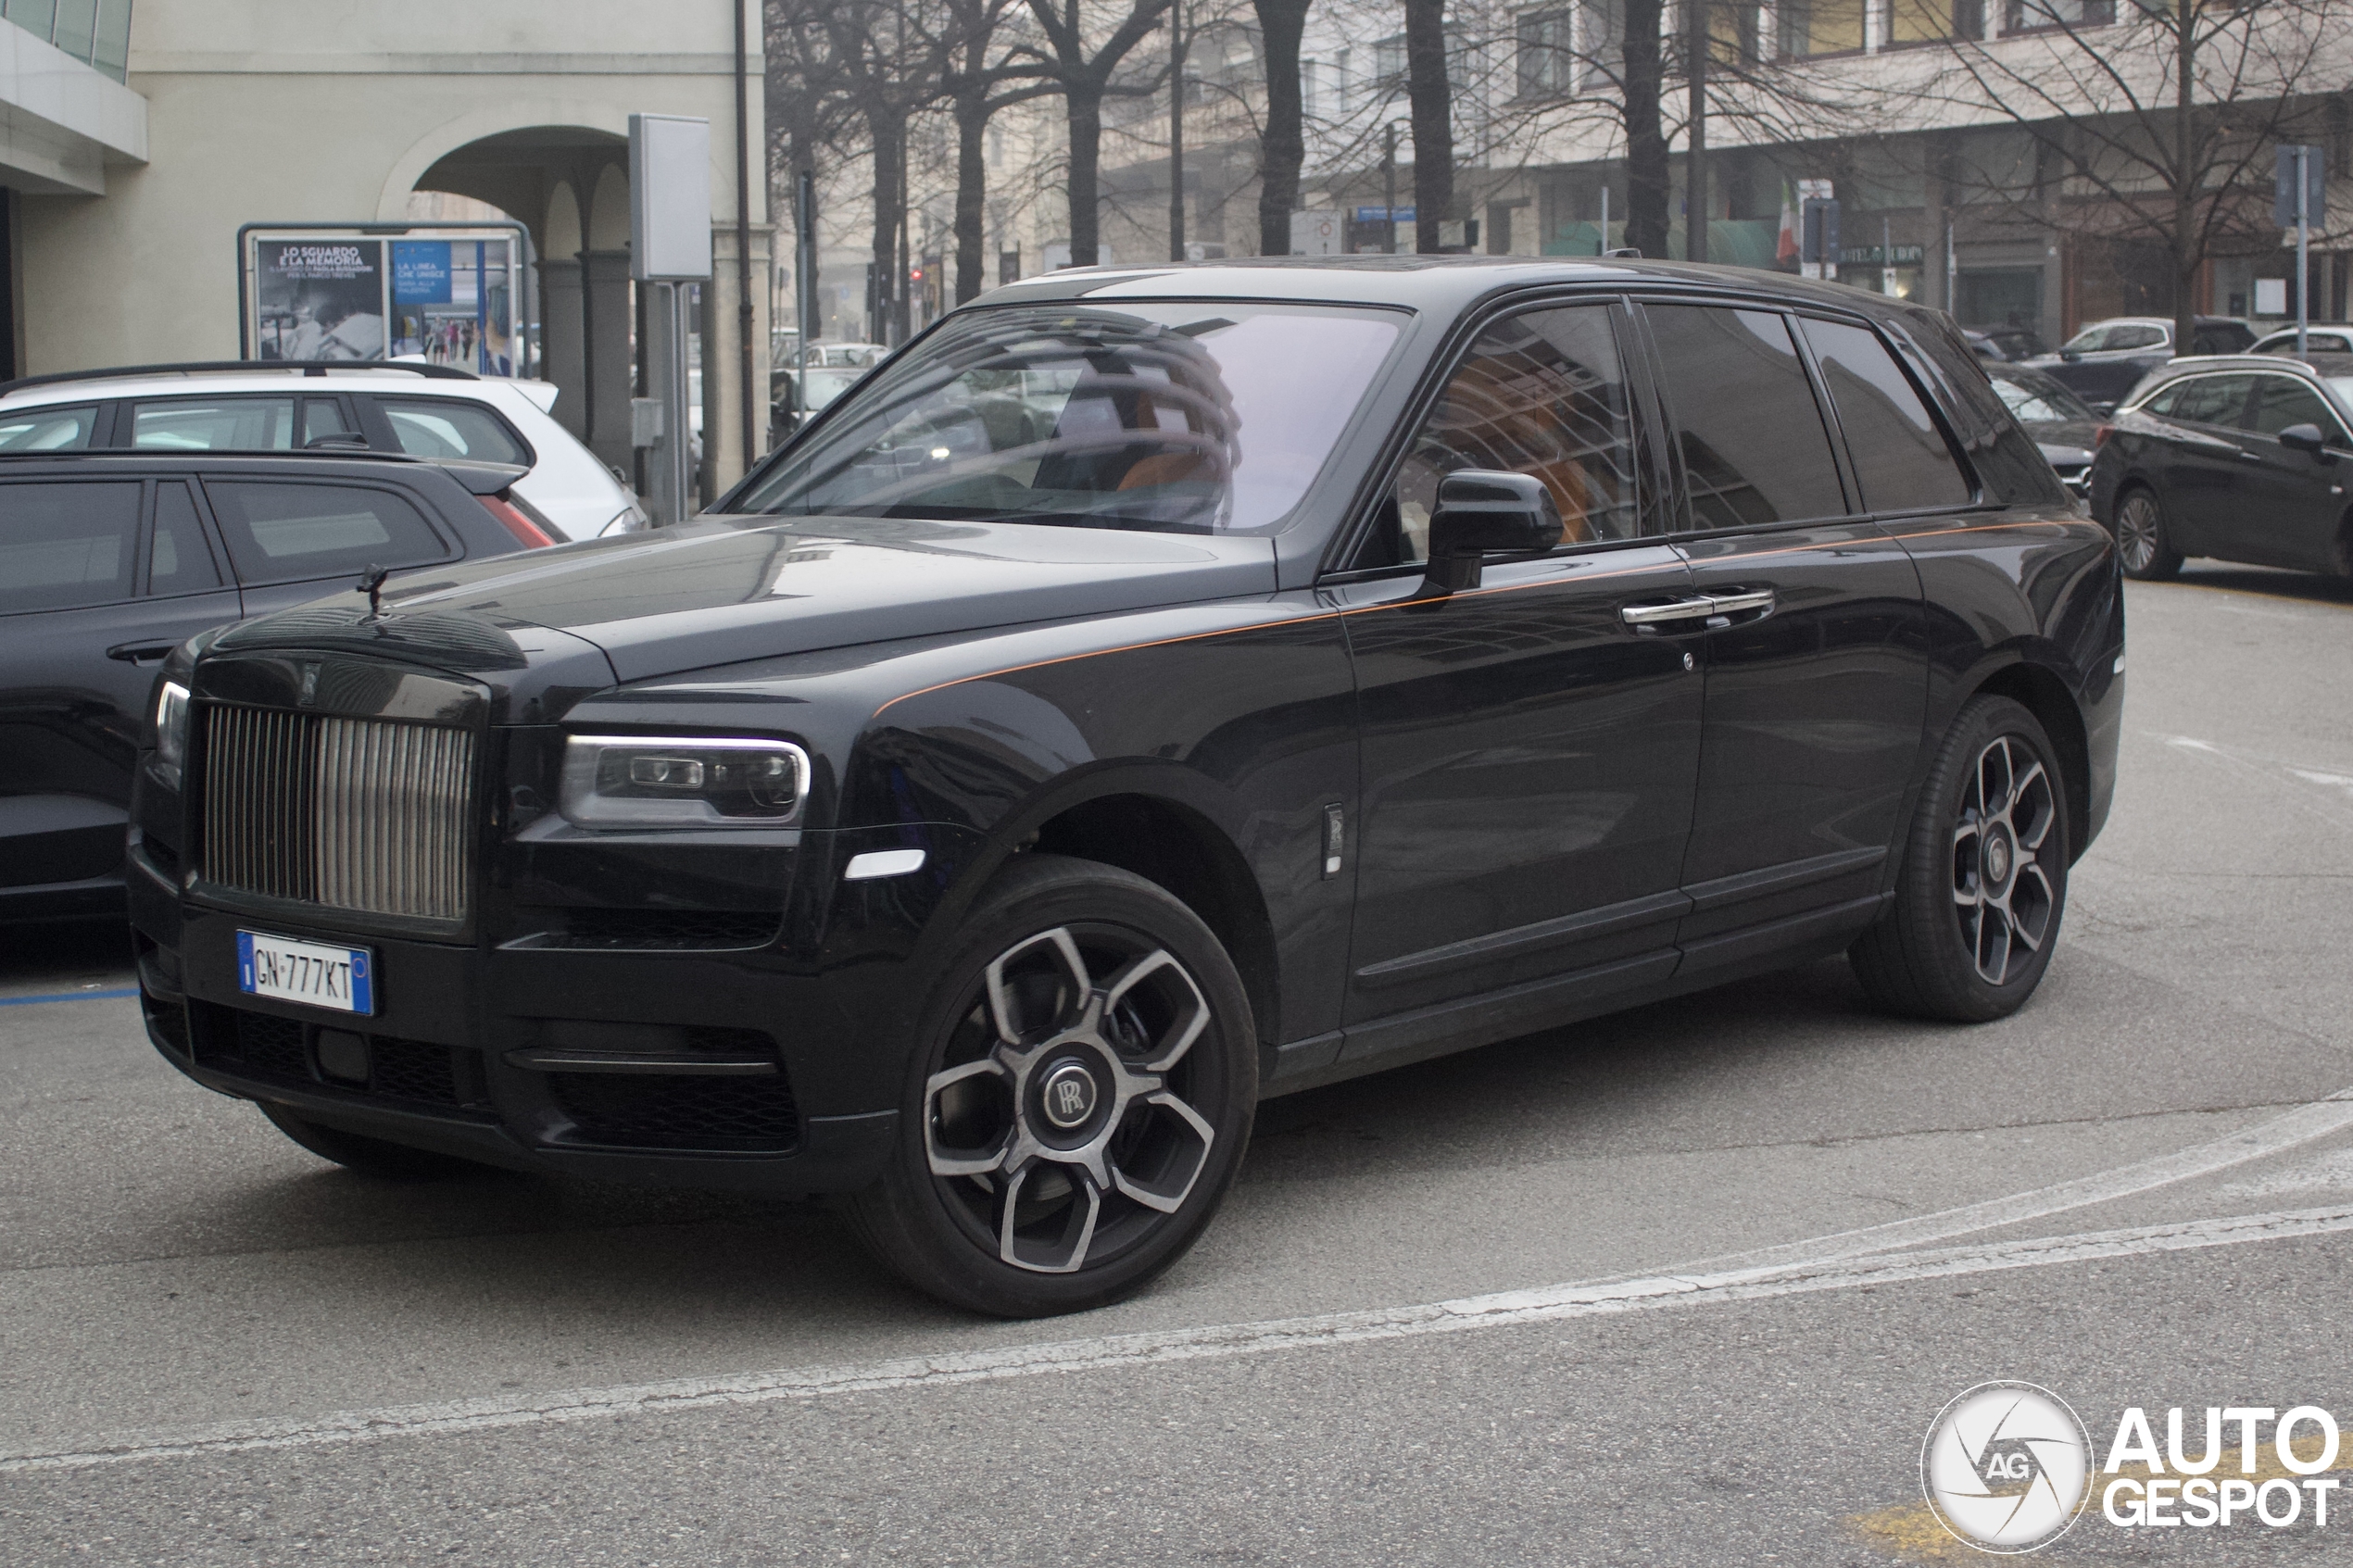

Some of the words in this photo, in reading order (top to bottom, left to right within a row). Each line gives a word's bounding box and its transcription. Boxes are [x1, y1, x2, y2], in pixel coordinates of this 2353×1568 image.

[283, 246, 299, 257] LO
[300, 246, 359, 257] SGUARDO
[279, 256, 287, 266] E
[289, 256, 304, 266] LA
[306, 256, 363, 266] MEMORIA
